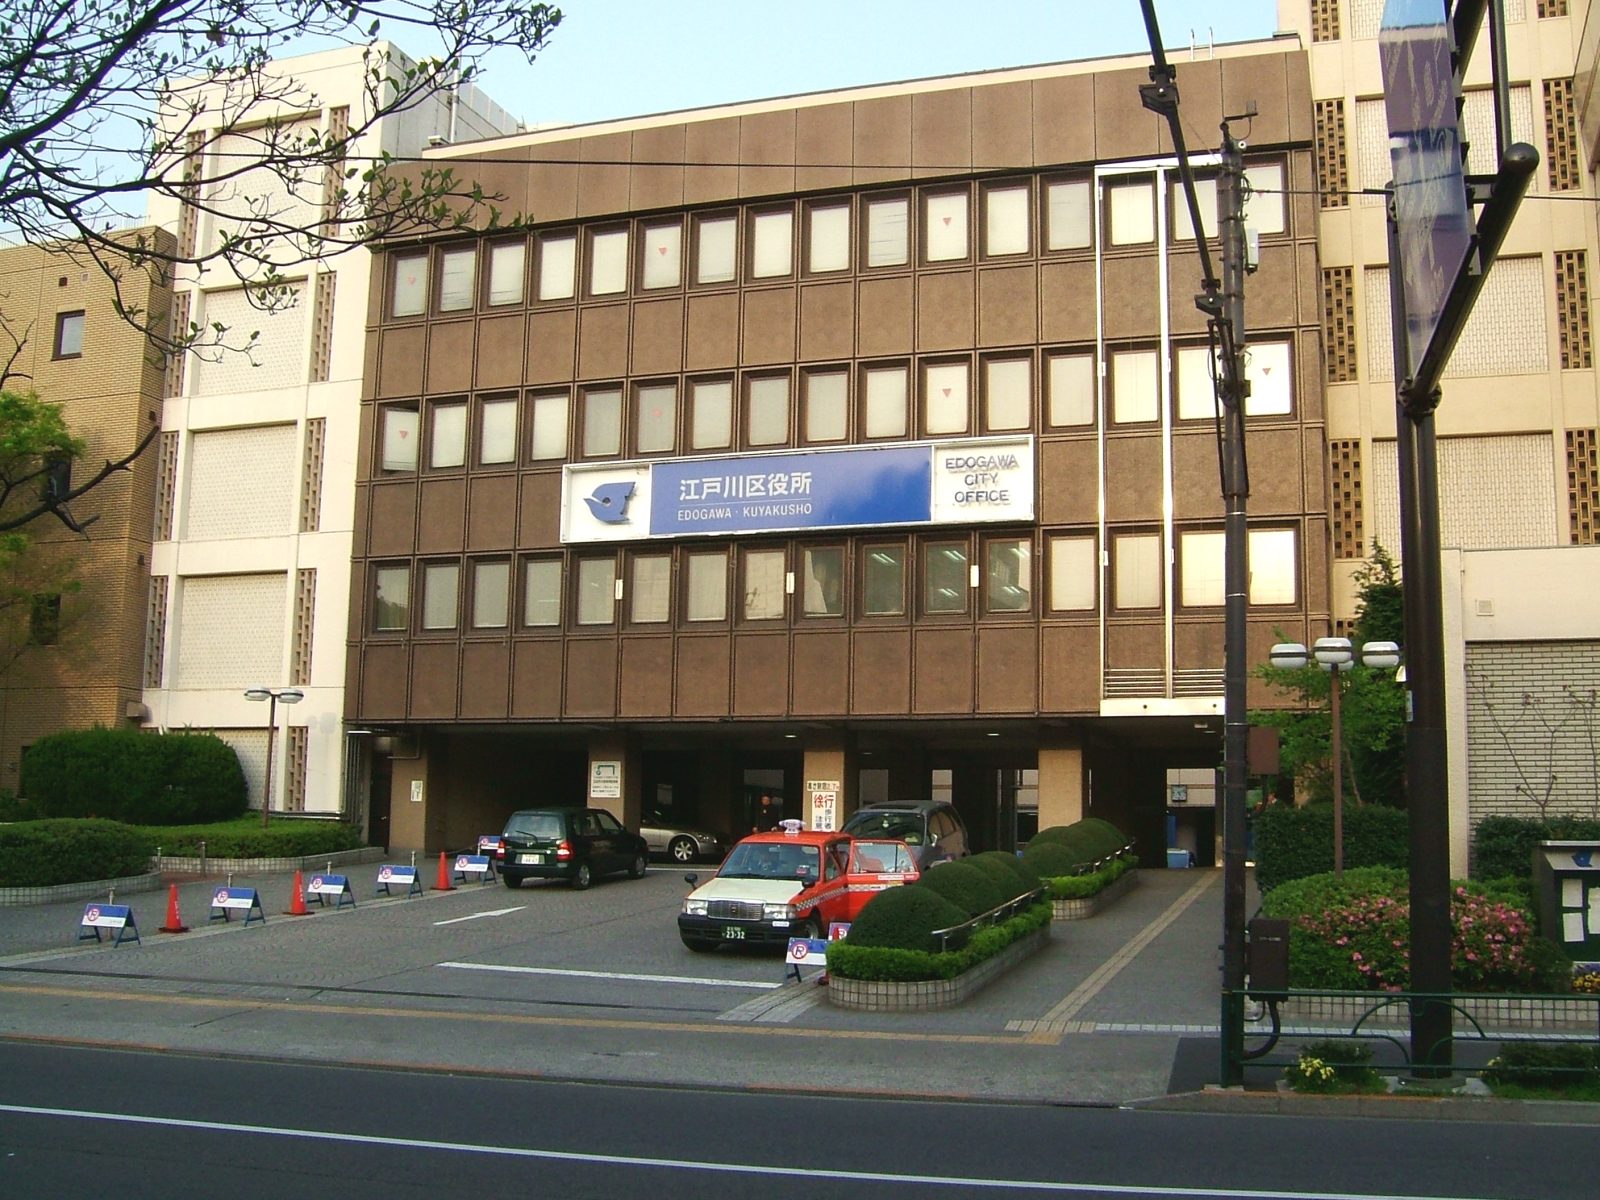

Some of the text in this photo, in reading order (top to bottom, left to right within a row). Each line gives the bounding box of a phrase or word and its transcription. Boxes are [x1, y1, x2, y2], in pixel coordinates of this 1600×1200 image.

[945, 454, 1019, 469] EDOGAWA
[679, 472, 812, 500] 江戸川区役所
[964, 473, 998, 486] CITY
[954, 490, 1009, 503] OFFICE
[677, 503, 812, 521] EDOGAWA KUYAKUSHO
[814, 794, 834, 808] 徐行
